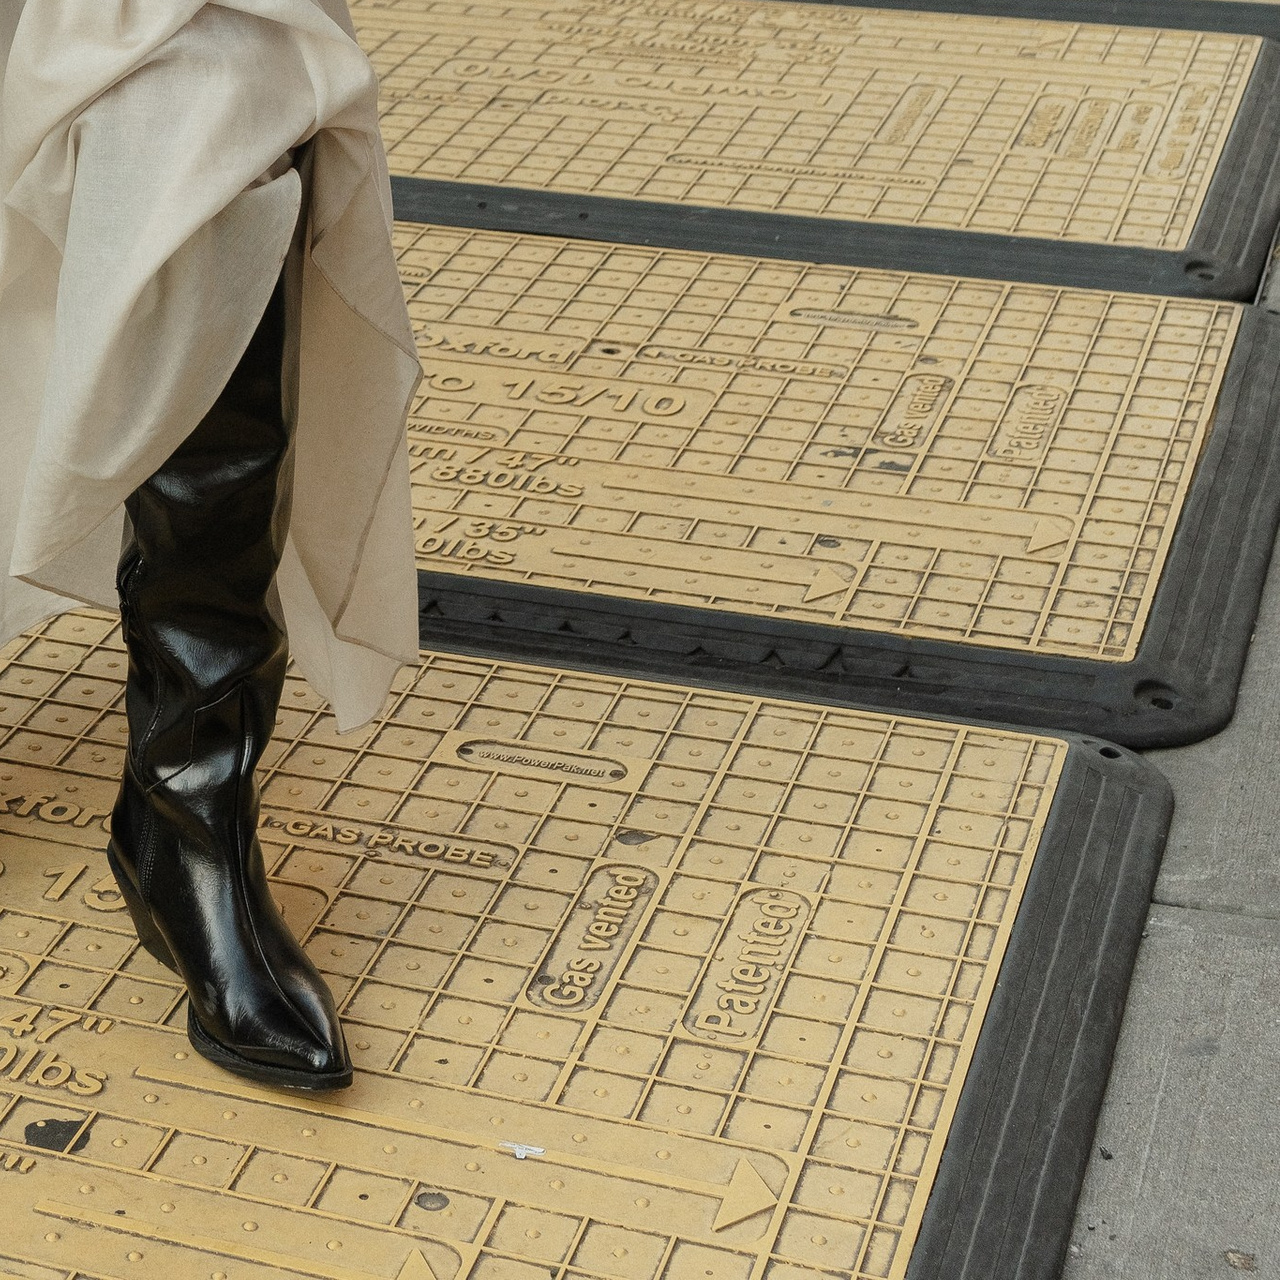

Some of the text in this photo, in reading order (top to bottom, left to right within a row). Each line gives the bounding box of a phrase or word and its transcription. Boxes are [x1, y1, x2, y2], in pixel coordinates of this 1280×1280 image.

[675, 350, 835, 376] GAS PROBE
[503, 379, 686, 417] 15/10
[883, 375, 946, 449] Gas vented
[996, 385, 1060, 461] Patented
[432, 465, 585, 497] 880lbs
[478, 749, 605, 777] www.PowerPak.net
[286, 818, 495, 868] GAS PROBE
[543, 869, 646, 1006] Gas vented
[694, 897, 801, 1037] Patented
